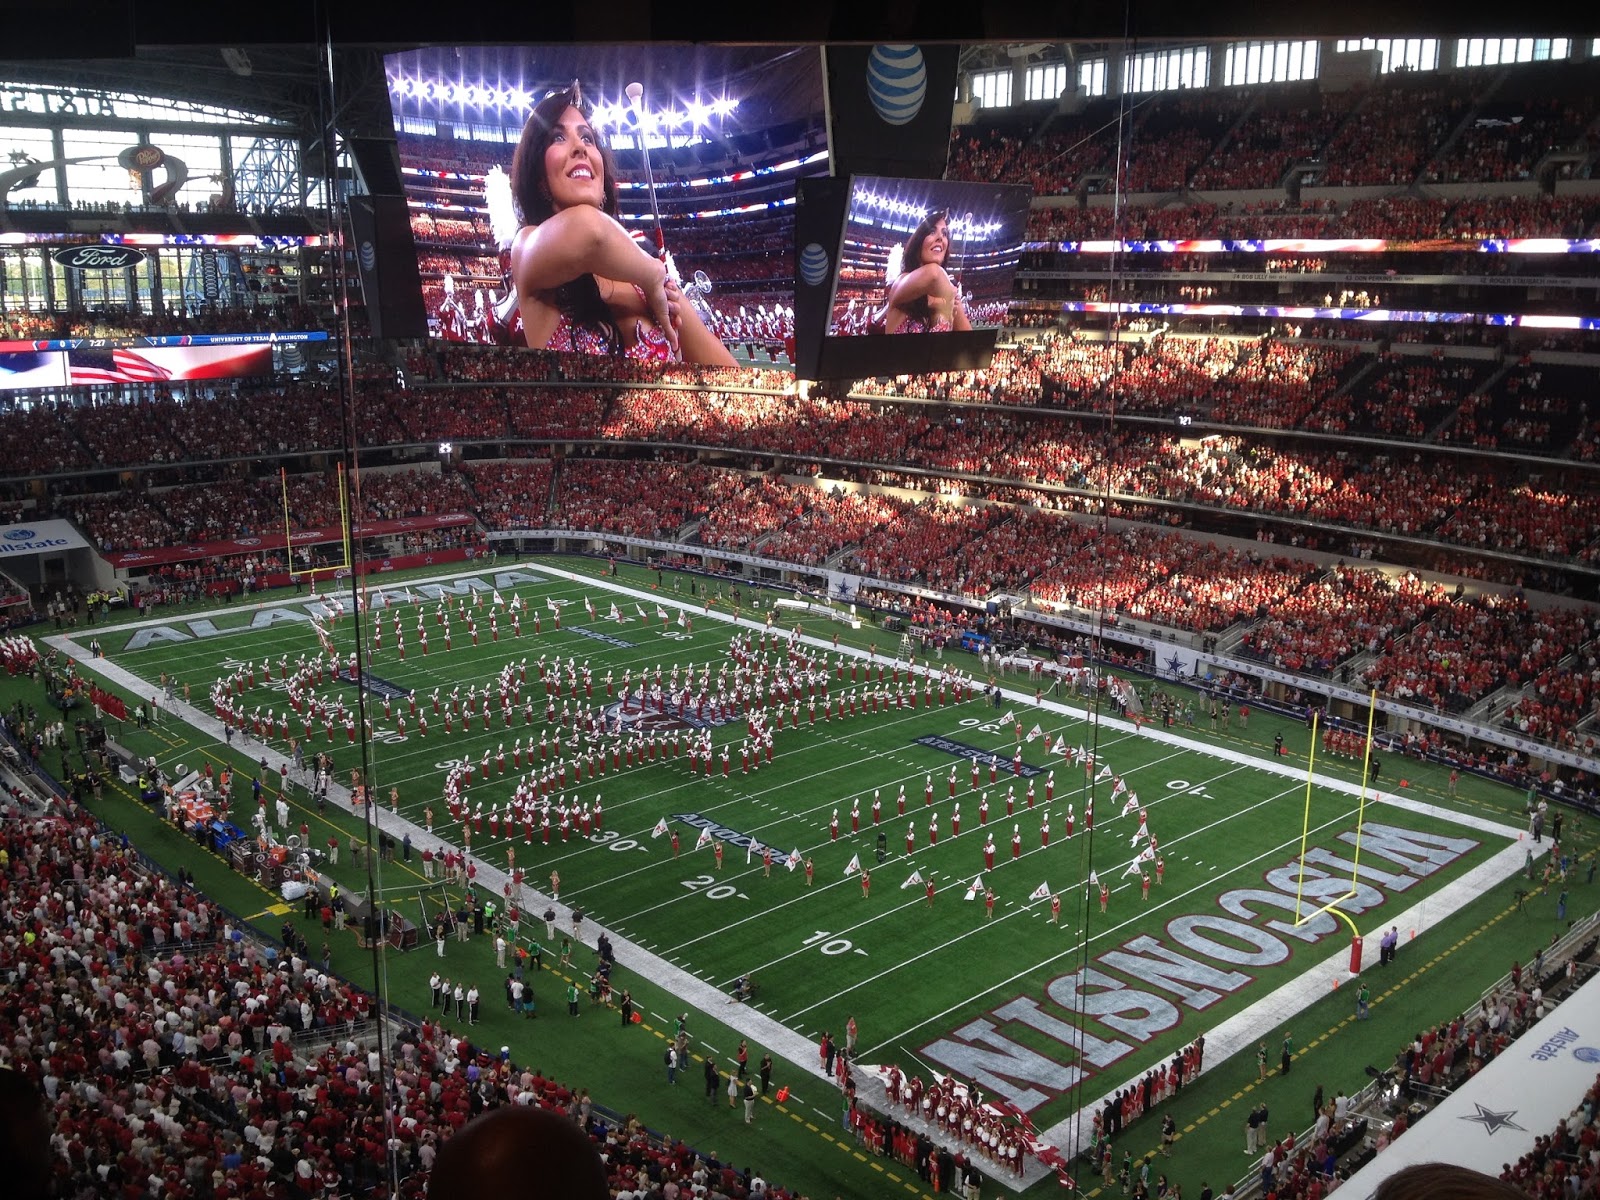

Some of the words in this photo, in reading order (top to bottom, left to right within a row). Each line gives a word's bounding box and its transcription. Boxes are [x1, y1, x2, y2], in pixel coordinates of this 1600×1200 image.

[72, 248, 128, 265] Ford
[89, 339, 106, 347] 7:27
[0, 539, 68, 552] llstate
[959, 718, 1001, 733] 30
[917, 736, 964, 754] AT&T
[1166, 780, 1207, 795] 10
[590, 831, 638, 852] 30
[681, 875, 737, 900] 20
[802, 930, 853, 956] 10
[919, 821, 1481, 1113] WISCONSIN
[1530, 1026, 1580, 1061] Allstate
